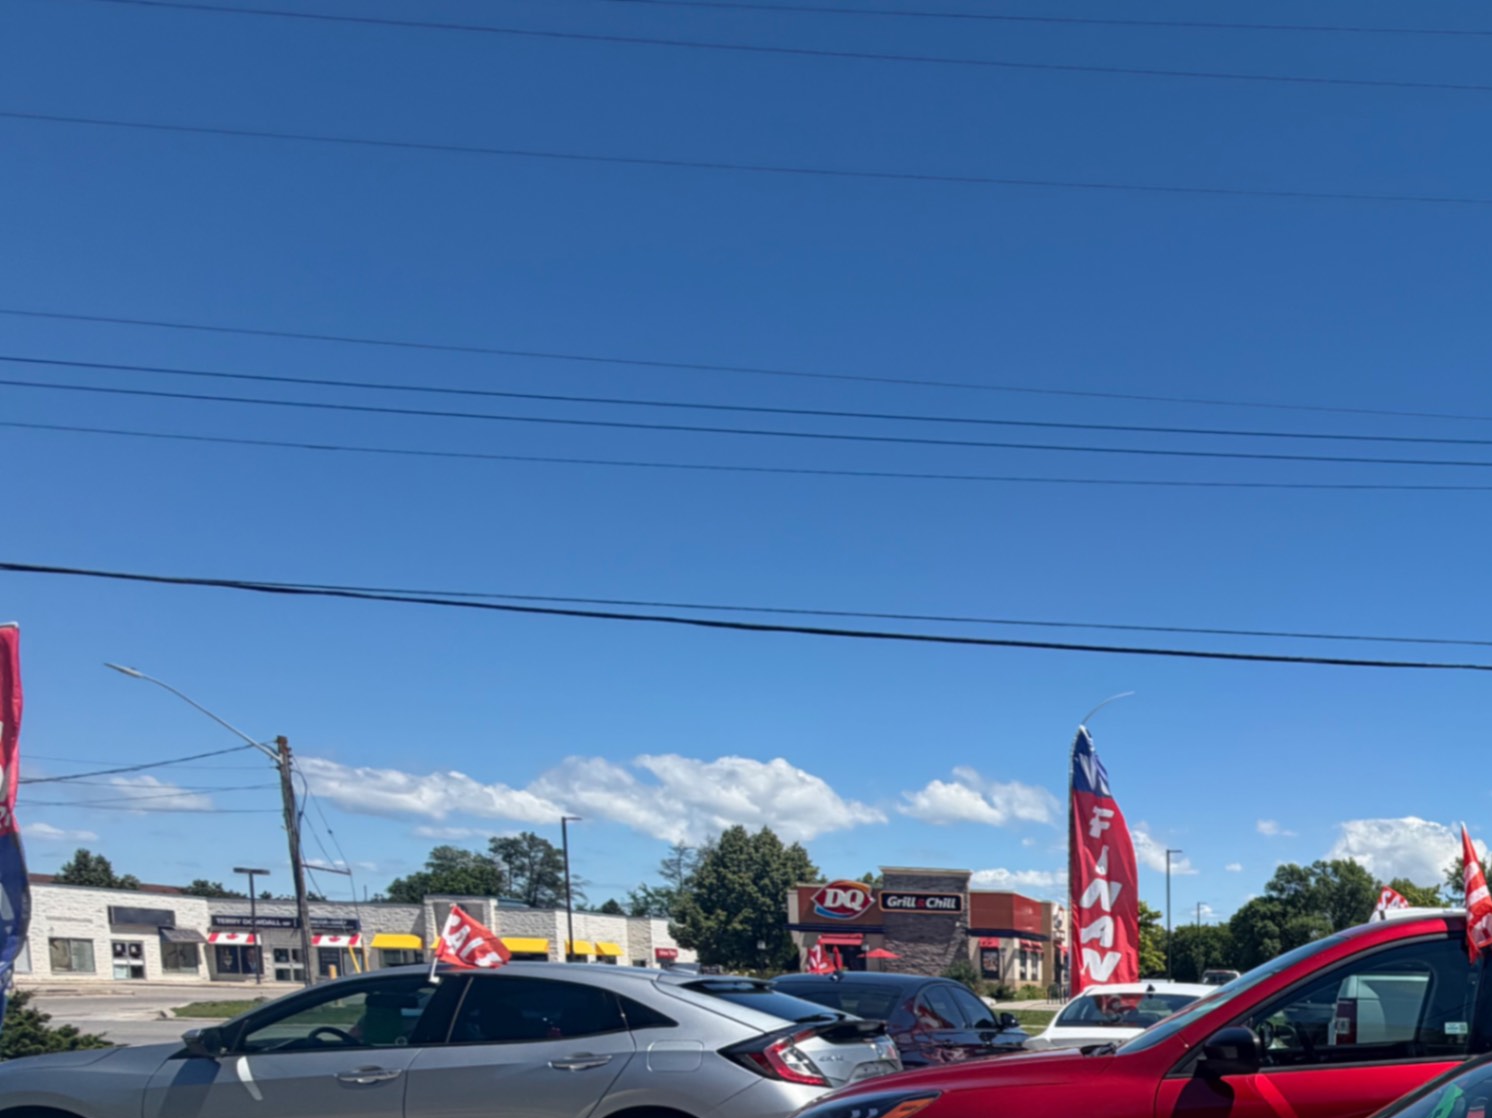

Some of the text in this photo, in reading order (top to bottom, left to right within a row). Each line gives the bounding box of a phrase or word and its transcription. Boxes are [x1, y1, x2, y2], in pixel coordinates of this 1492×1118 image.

[824, 888, 865, 911] DQ
[886, 895, 916, 908] Grill
[926, 896, 957, 909] Chill
